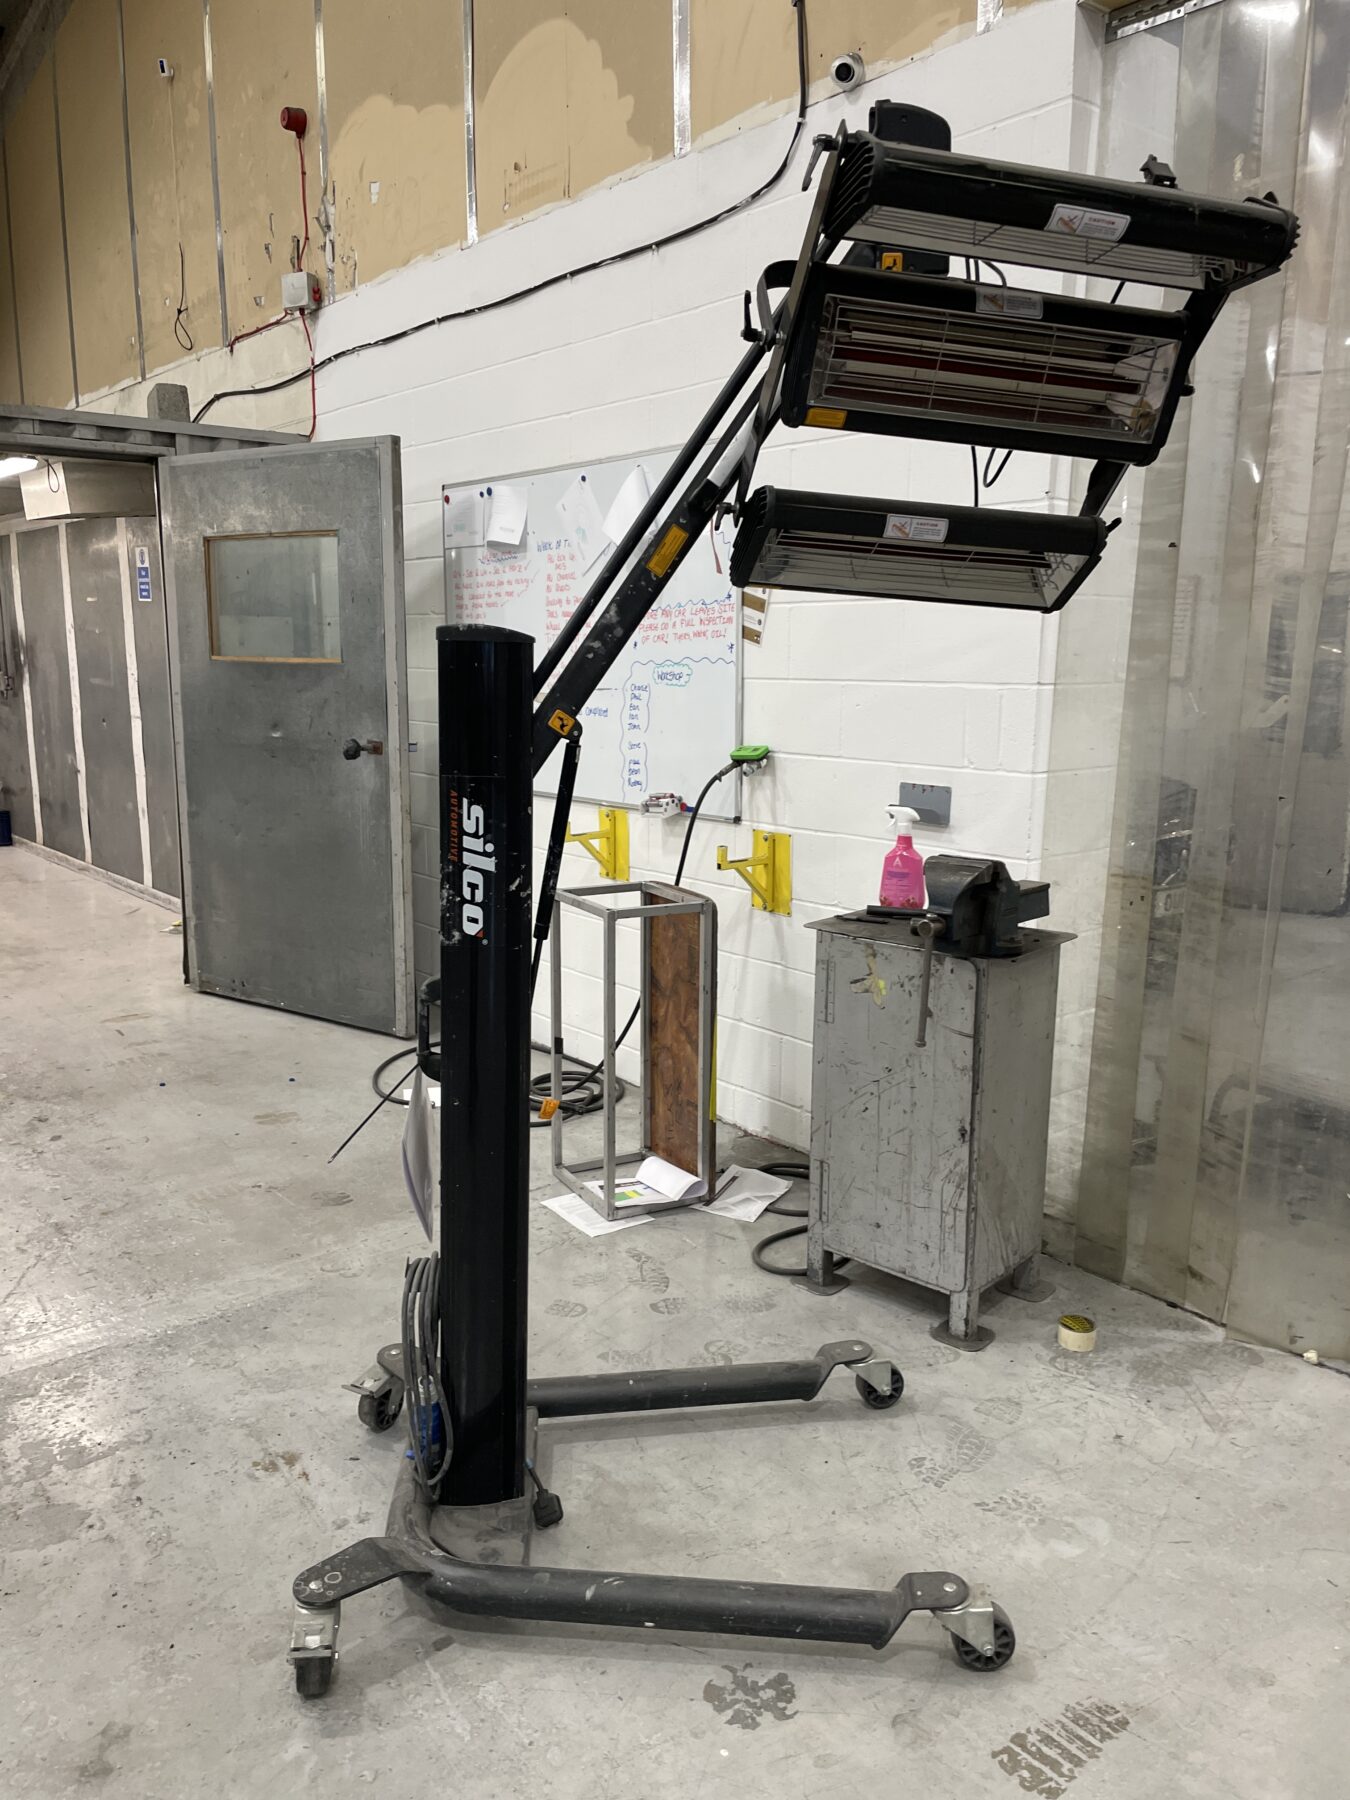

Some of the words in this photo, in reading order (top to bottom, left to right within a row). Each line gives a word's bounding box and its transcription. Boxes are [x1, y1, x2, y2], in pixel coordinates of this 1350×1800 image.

[674, 608, 687, 618] CAR
[690, 606, 716, 616] LEAVES
[717, 603, 736, 614] SITE
[449, 789, 459, 863] AUTOMOTIVE
[462, 797, 498, 938] silco
